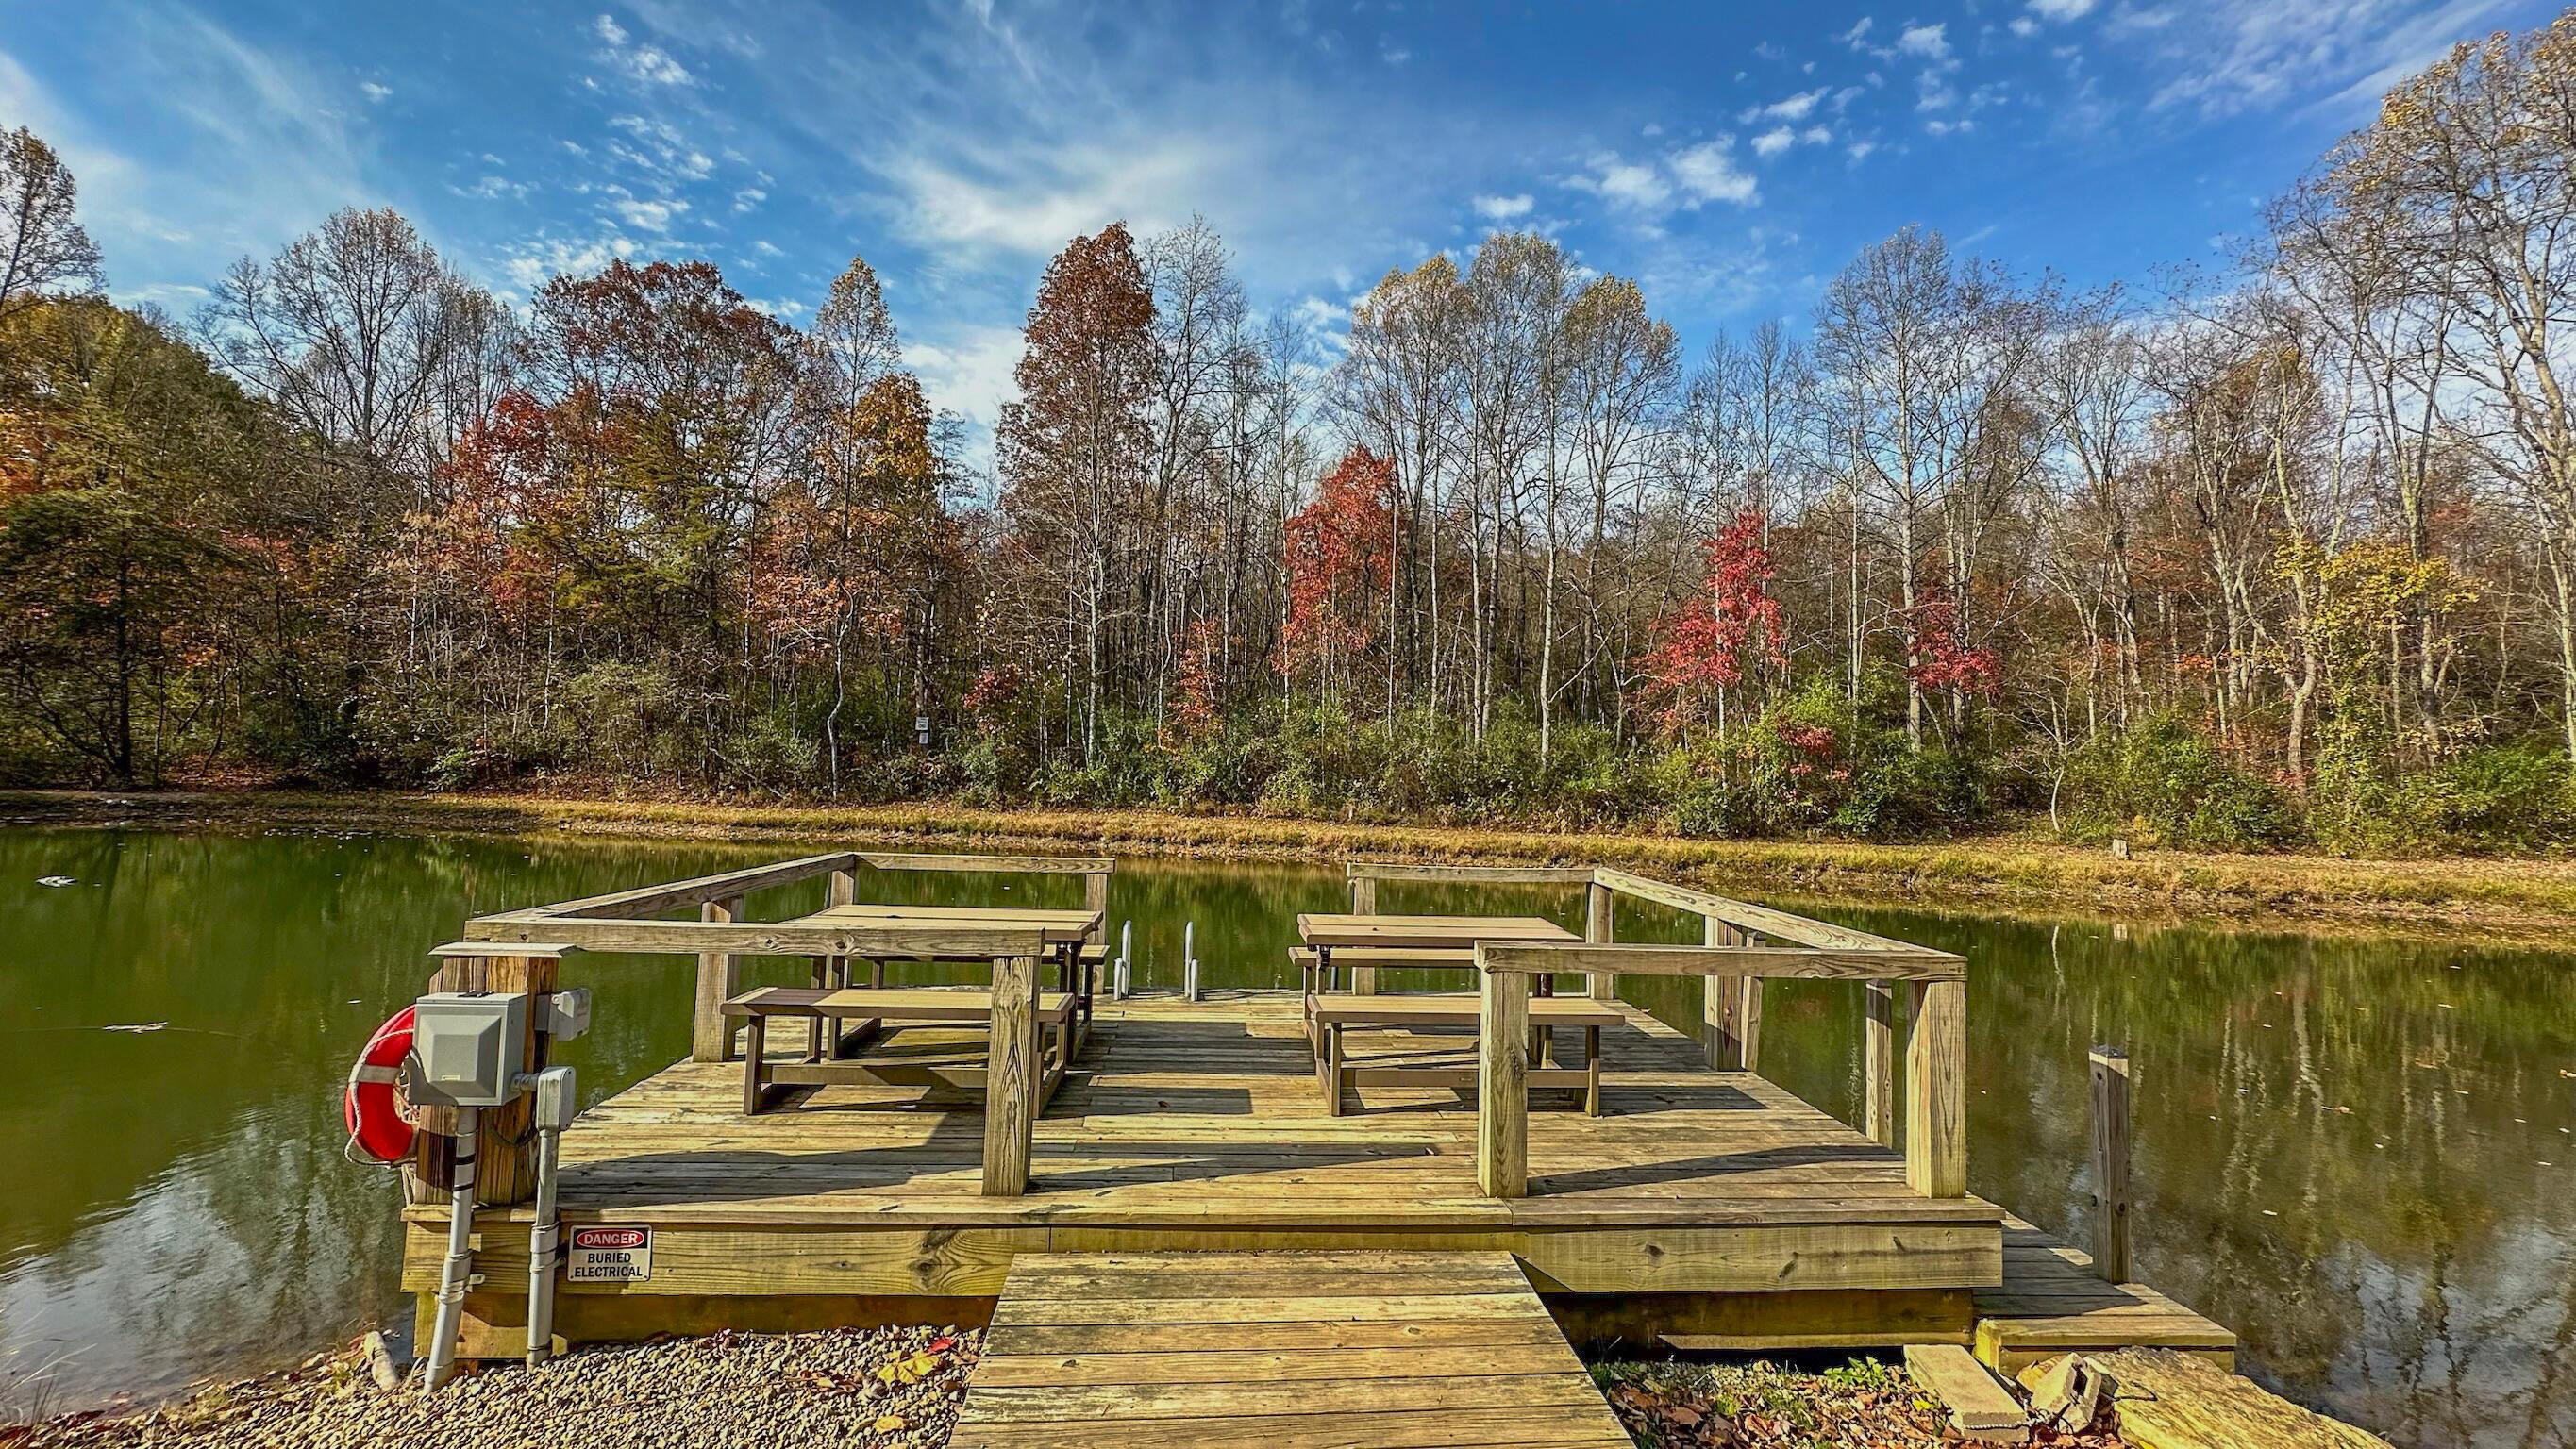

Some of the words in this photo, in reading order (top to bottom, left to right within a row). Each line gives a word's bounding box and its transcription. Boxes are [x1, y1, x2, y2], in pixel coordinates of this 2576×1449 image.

[584, 1233, 638, 1244] DANGER
[588, 1253, 631, 1263] BURIED
[575, 1266, 643, 1277] ELECTRICAL
